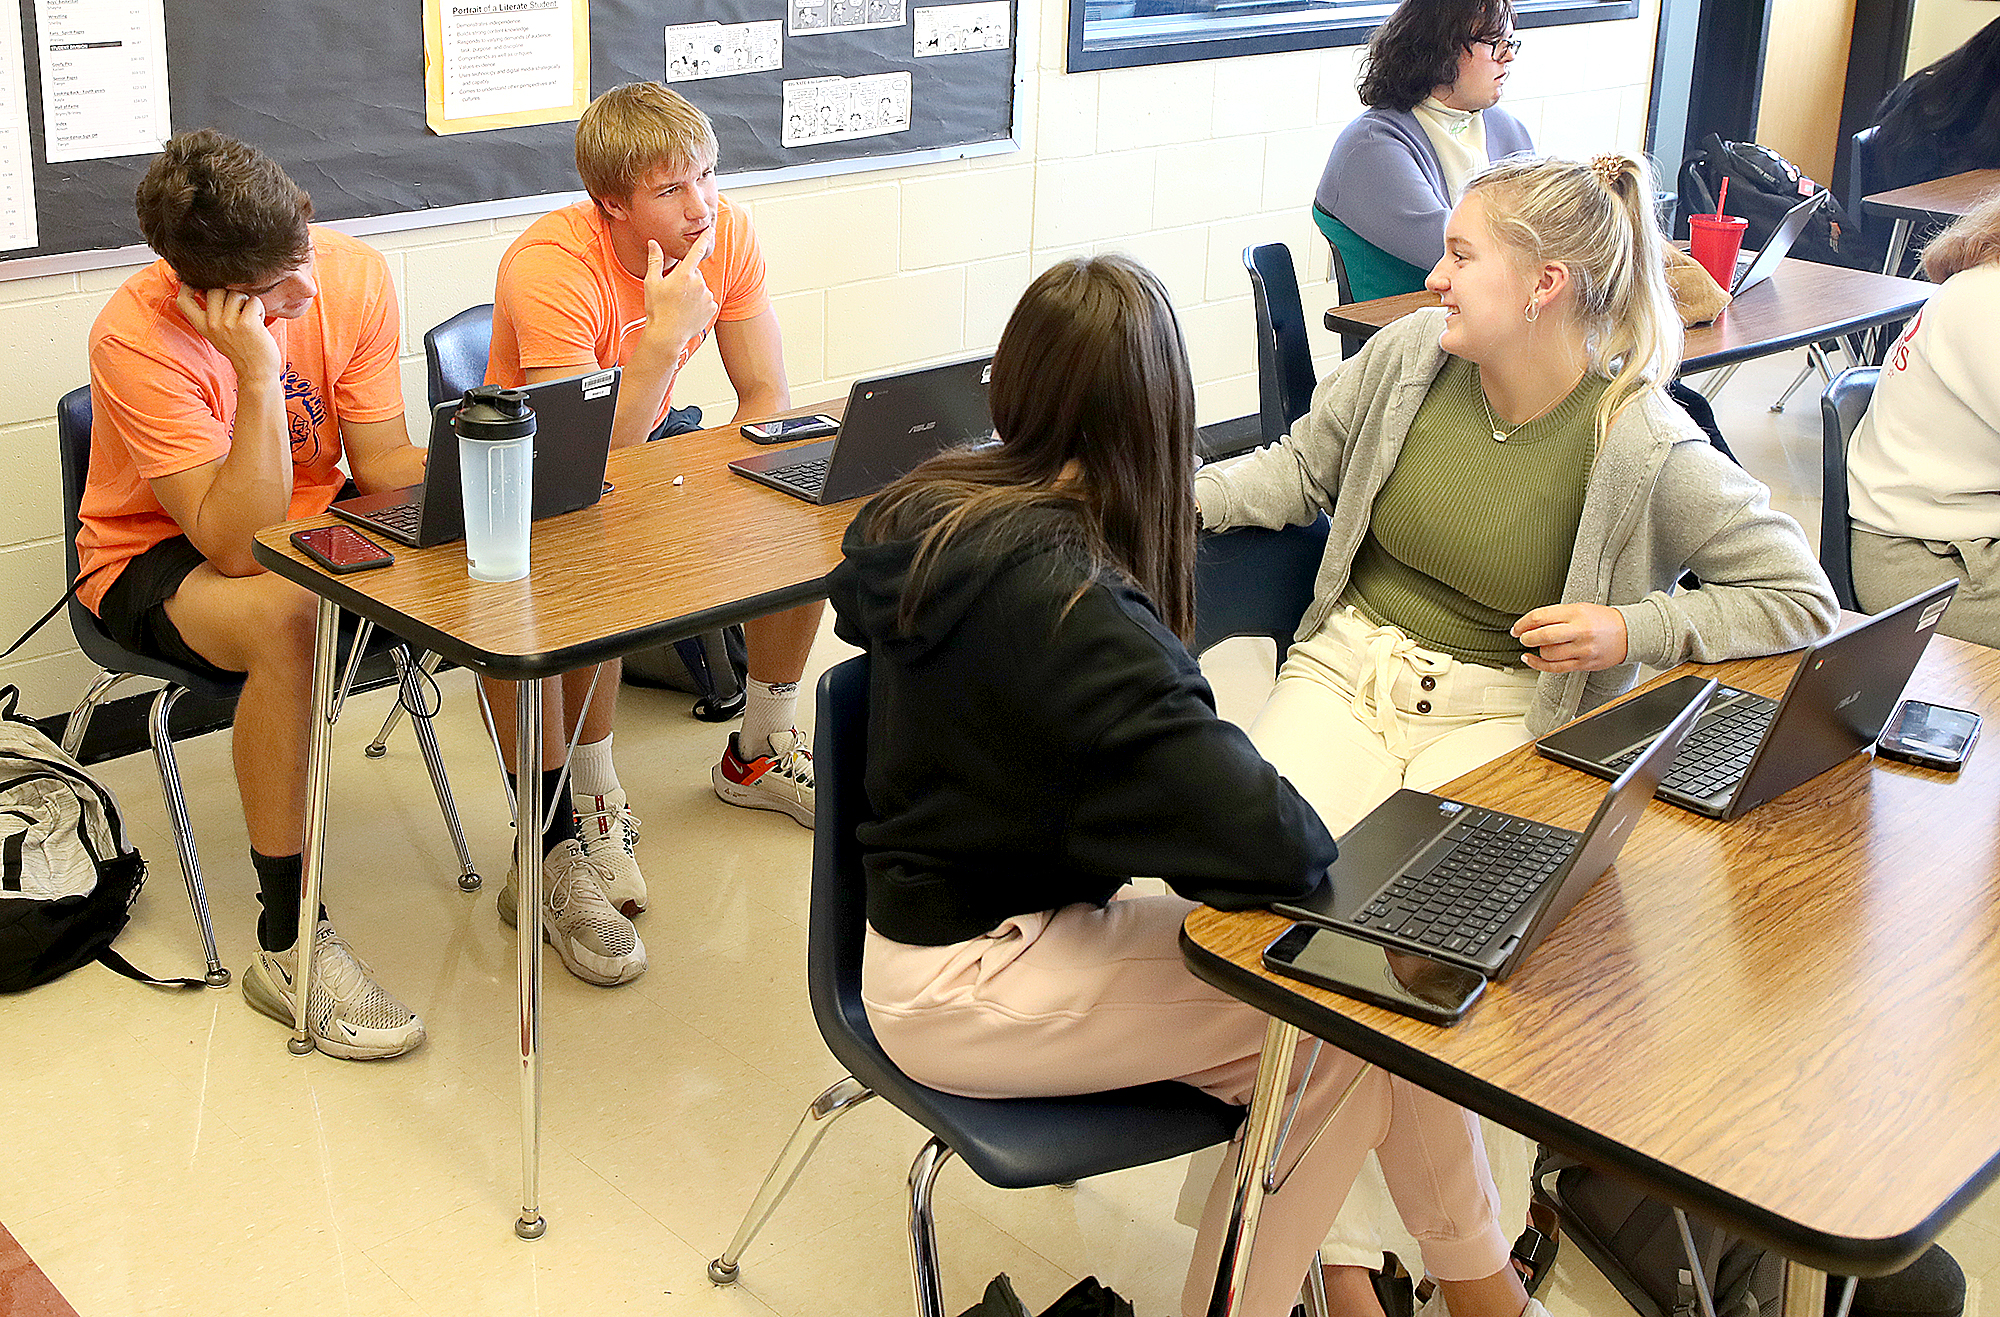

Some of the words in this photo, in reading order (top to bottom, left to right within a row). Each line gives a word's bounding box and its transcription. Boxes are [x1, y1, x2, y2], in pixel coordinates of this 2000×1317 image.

[452, 5, 482, 15] Portrait
[483, 4, 491, 12] of
[499, 2, 528, 12] Literate
[529, 0, 557, 9] Student
